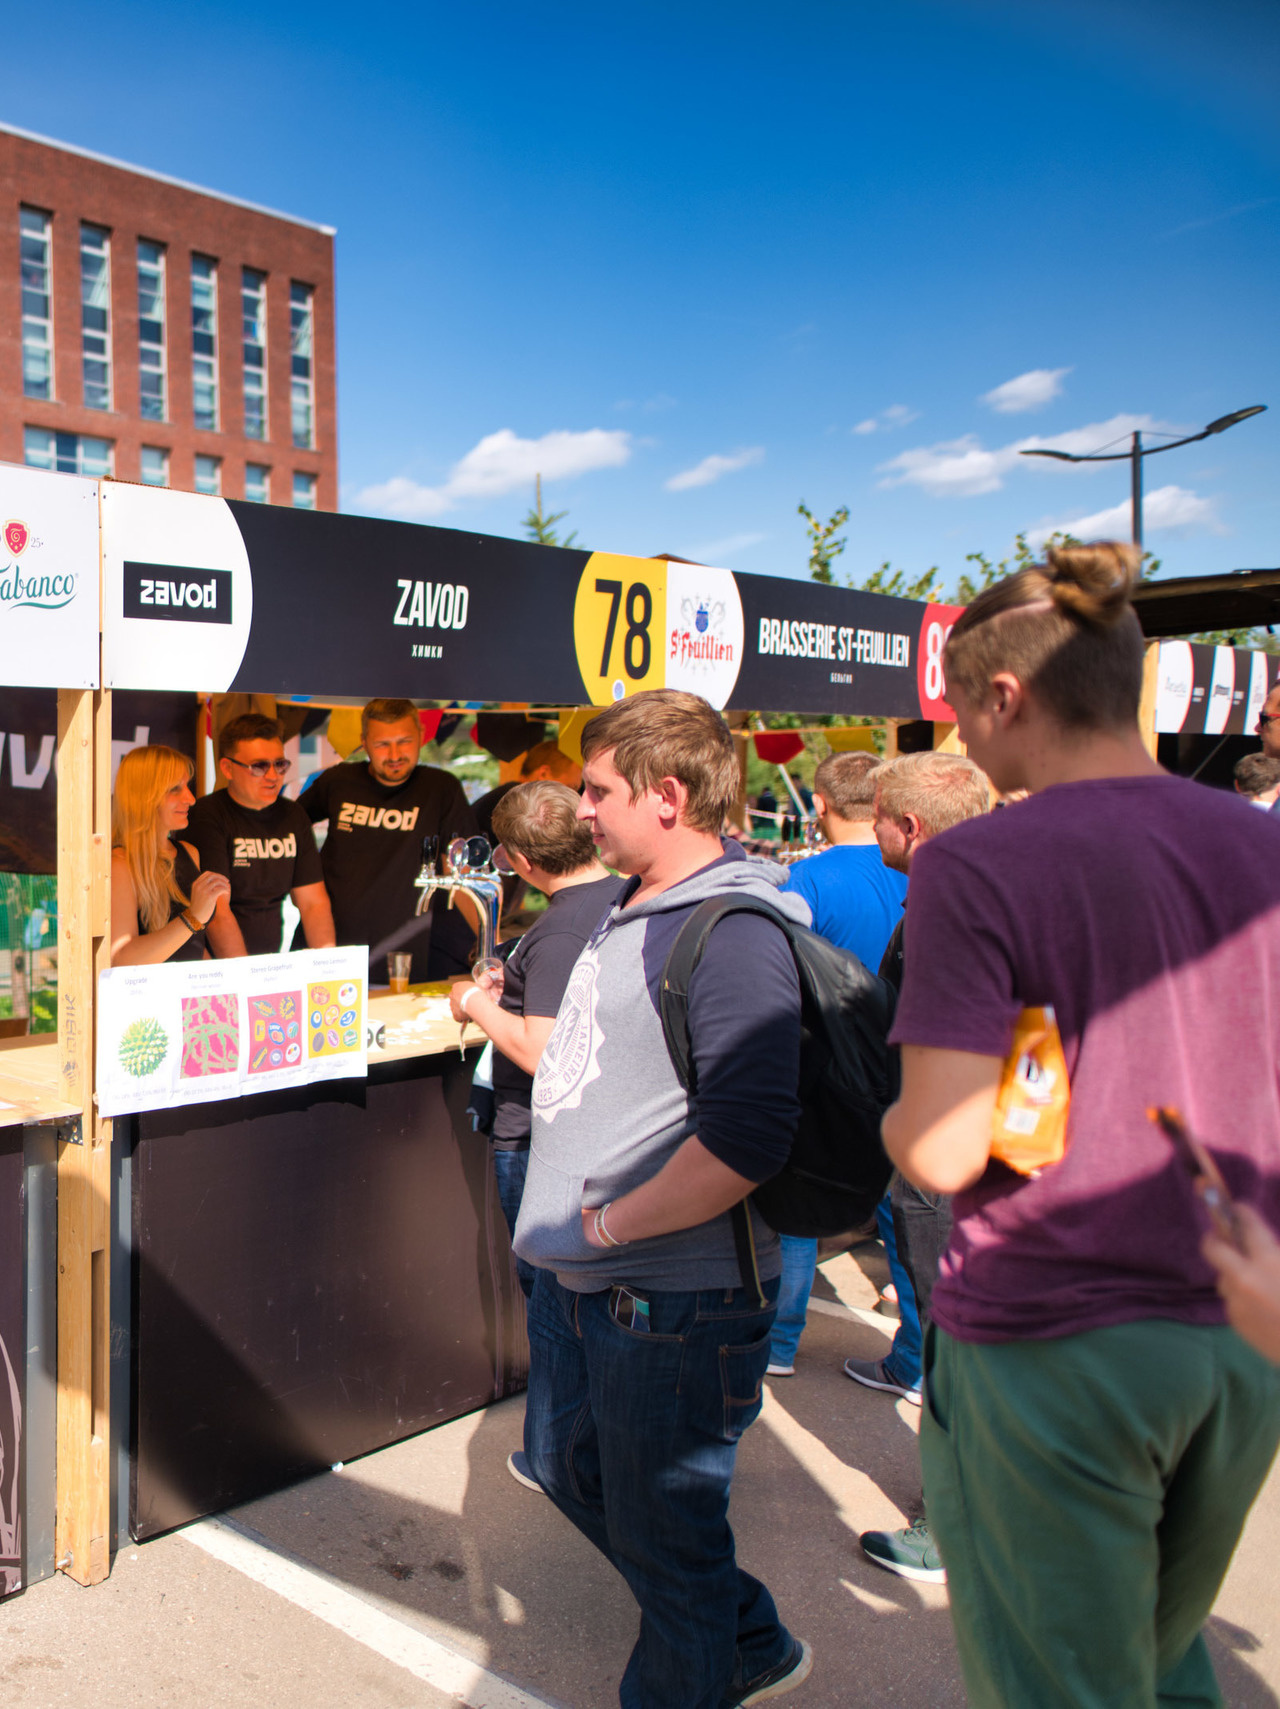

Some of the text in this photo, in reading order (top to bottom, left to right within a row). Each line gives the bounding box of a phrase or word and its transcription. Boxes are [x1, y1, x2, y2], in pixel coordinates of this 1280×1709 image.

[139, 578, 217, 609] zavod
[393, 579, 469, 630] ZAVOD
[594, 578, 652, 680] 78
[758, 617, 910, 668] BRASSERIE ST-FEUILLIEN
[411, 643, 443, 659] ХИМКИ
[925, 622, 954, 700] 8
[346, 802, 419, 831] zavod
[234, 833, 297, 858] zavod
